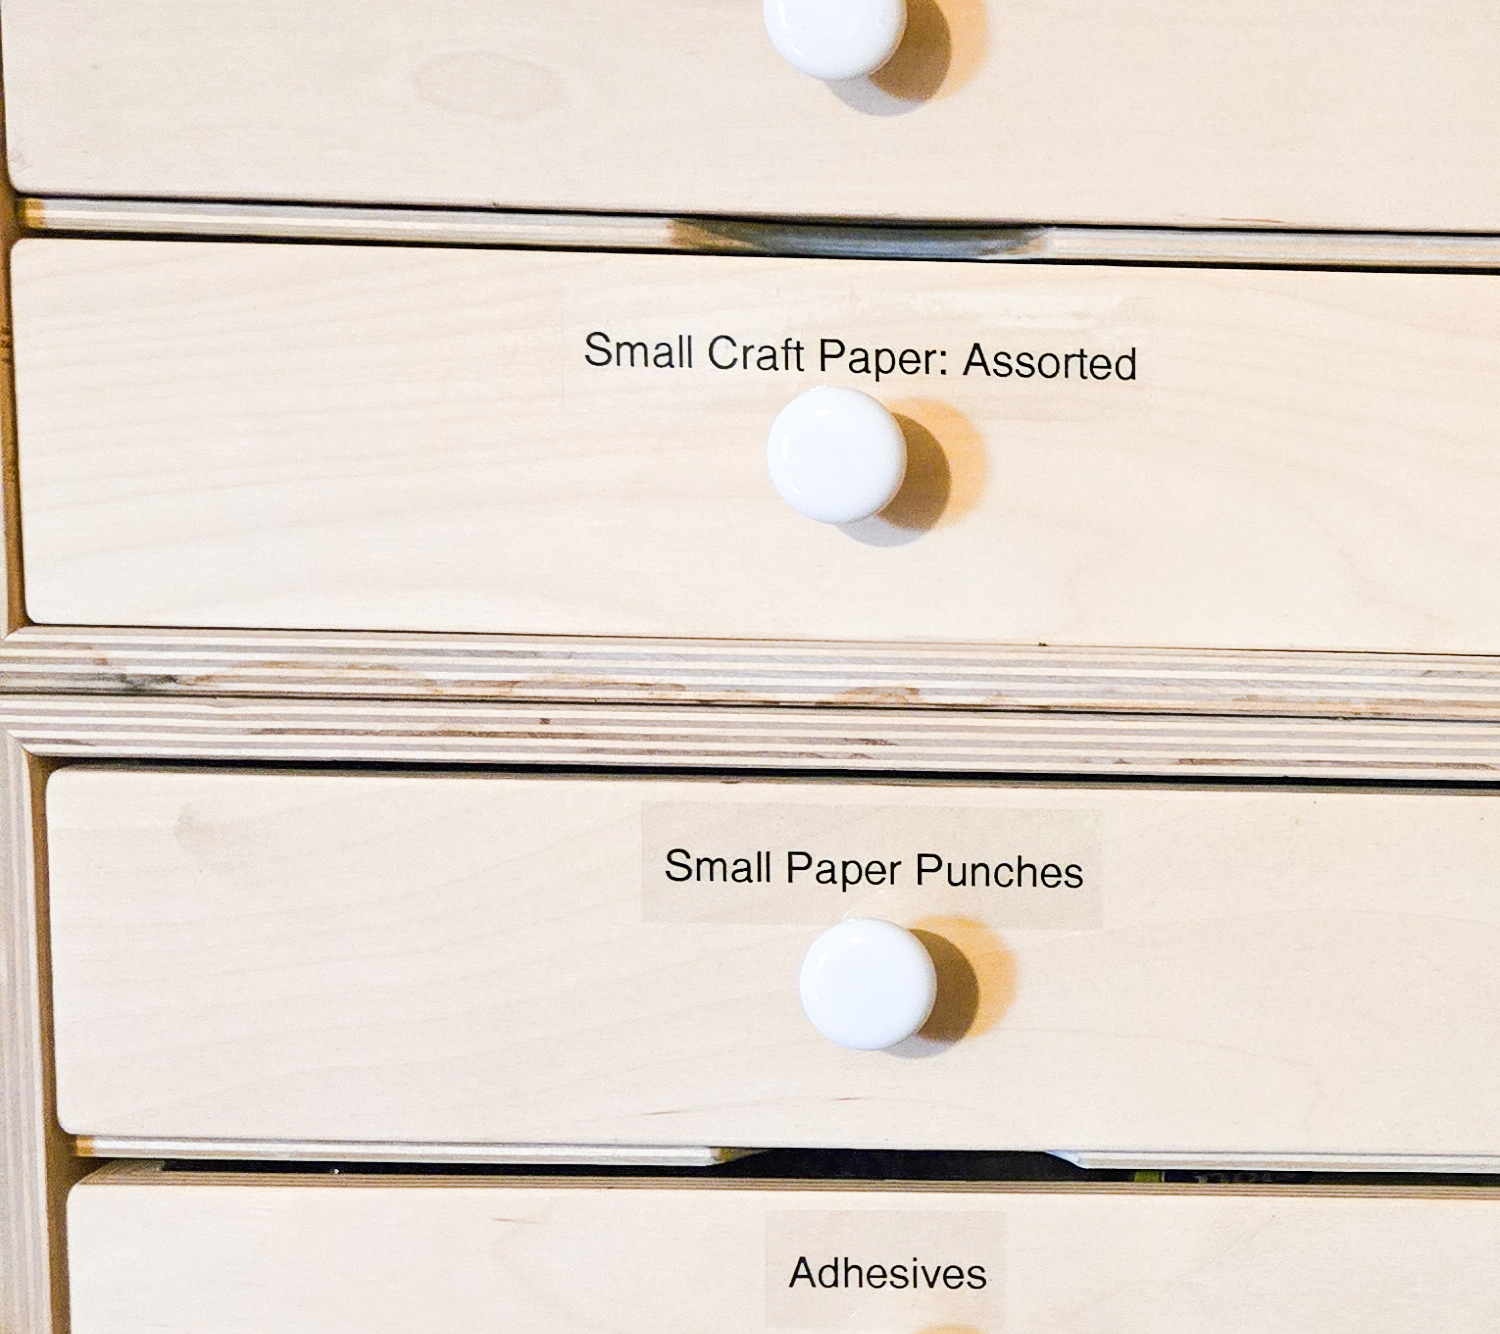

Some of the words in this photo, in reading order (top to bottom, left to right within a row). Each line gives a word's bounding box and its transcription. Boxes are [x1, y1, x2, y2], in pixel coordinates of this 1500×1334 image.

[584, 331, 693, 369] Small
[708, 334, 805, 372] Craft
[820, 338, 947, 383] Paper:
[962, 342, 1136, 381] Assorted
[665, 848, 771, 884] Small
[787, 851, 902, 893] Paper
[917, 853, 1084, 889] Punches
[788, 1256, 987, 1290] Adhesives
